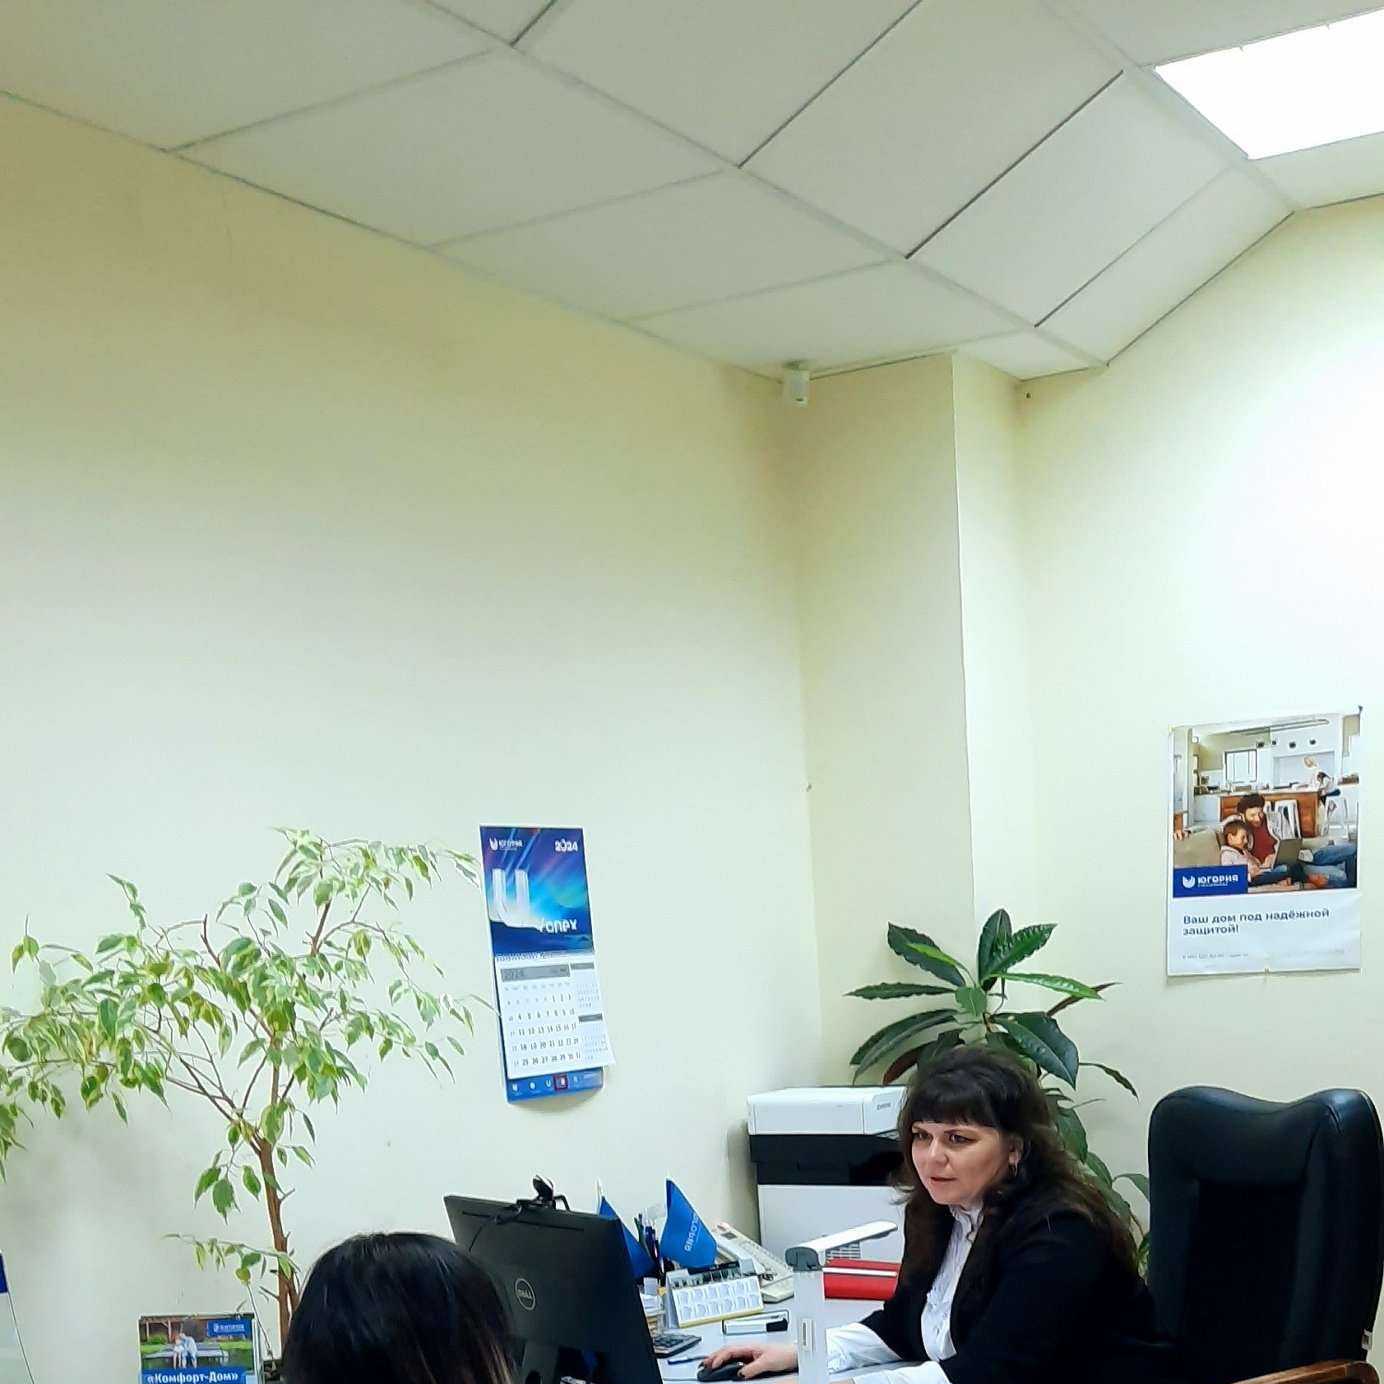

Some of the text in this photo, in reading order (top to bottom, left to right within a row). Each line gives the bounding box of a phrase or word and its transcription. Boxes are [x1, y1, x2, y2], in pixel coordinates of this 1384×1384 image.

[555, 839, 578, 852] 2024
[1197, 874, 1238, 884] ЮГОРИЯ
[1184, 915, 1208, 924] Ваш
[1212, 915, 1236, 923] дом
[1266, 908, 1329, 920] надёжной
[1183, 924, 1238, 935] защитой!
[147, 1371, 238, 1384] «Комфорт-Дом»
